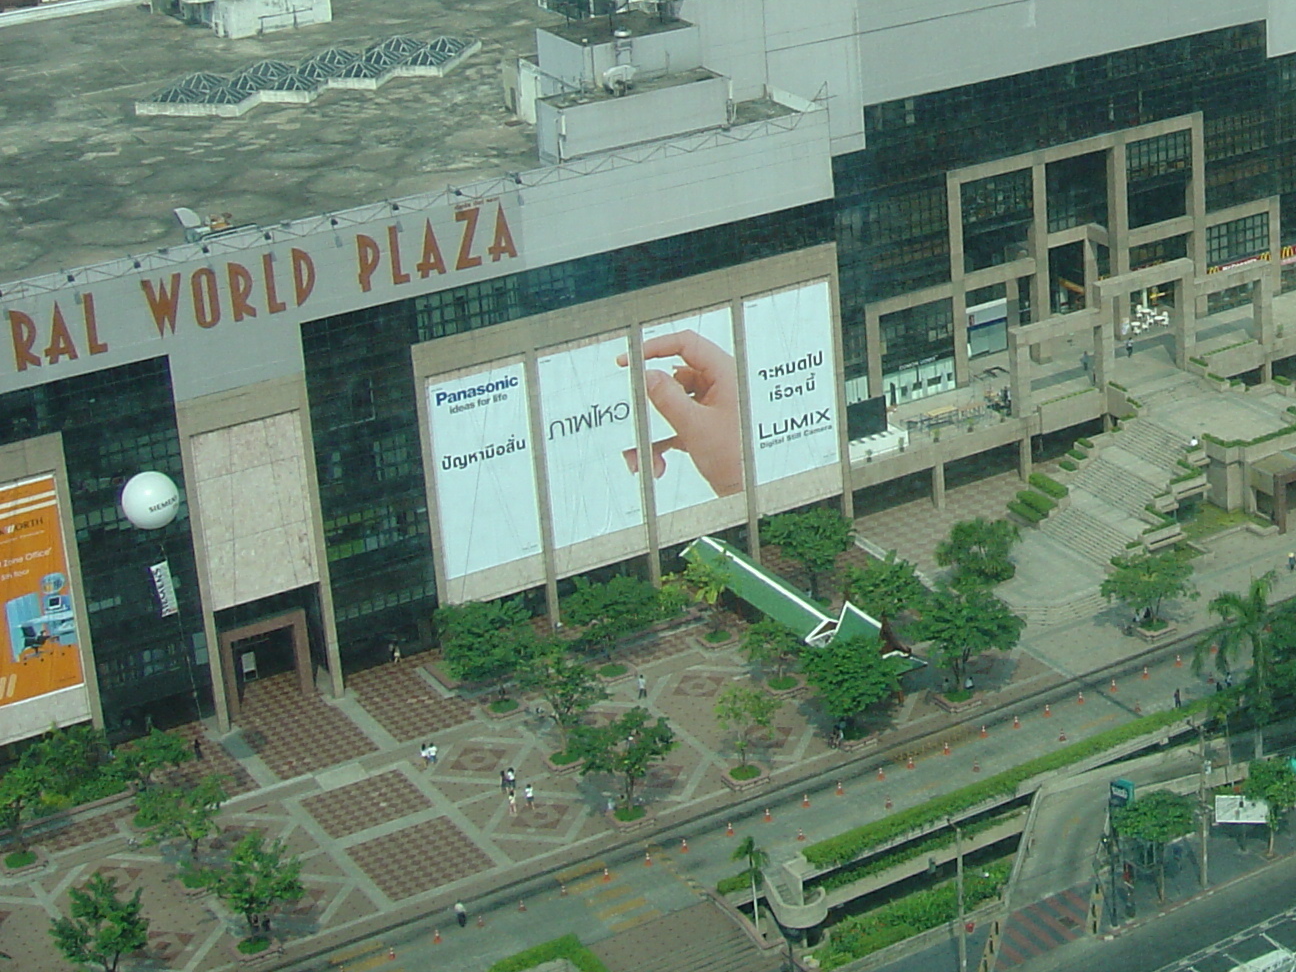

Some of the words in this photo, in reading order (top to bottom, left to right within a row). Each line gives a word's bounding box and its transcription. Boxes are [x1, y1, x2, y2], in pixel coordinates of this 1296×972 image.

[141, 247, 315, 339] WORLD
[356, 201, 518, 293] PLAZA
[758, 350, 823, 380] จะหมดไป
[436, 375, 519, 406] Panasonic
[449, 402, 475, 415] ideas
[477, 398, 491, 407] for
[493, 393, 508, 403] life
[548, 402, 630, 440] ภาพไหว
[758, 408, 831, 439] LUMIX
[442, 434, 526, 470] ปัญหามือสั่น
[760, 437, 785, 449] Digital
[786, 432, 802, 442] Still
[803, 425, 833, 437] Camera
